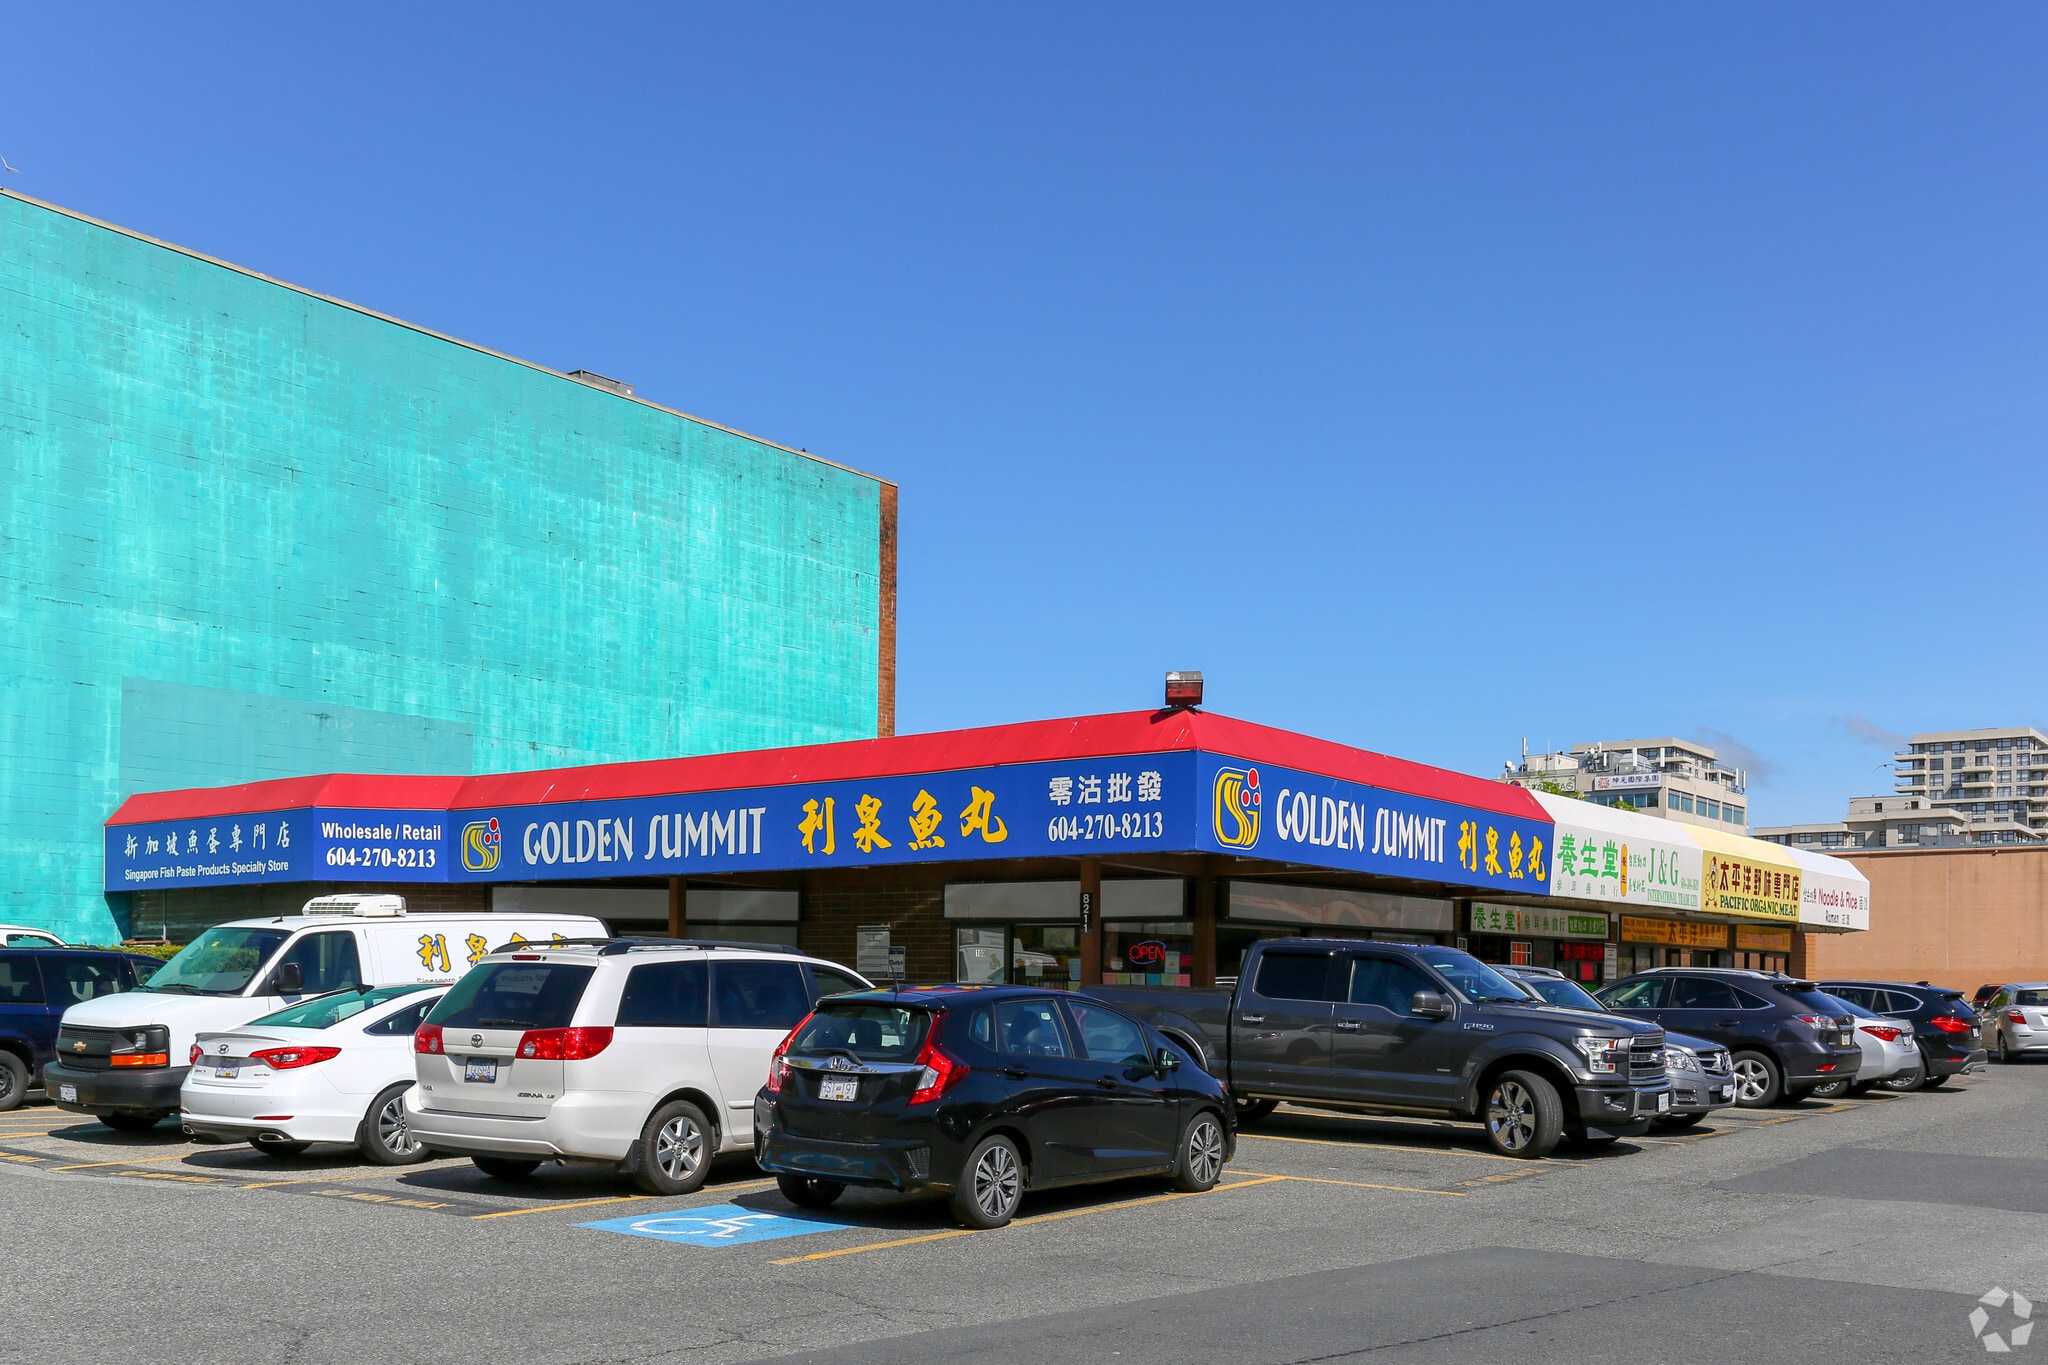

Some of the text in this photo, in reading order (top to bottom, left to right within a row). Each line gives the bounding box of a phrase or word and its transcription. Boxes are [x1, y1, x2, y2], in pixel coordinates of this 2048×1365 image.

[1048, 771, 1163, 806] 零沽批發
[322, 822, 392, 841] Wholesale
[403, 824, 441, 841] Retail
[523, 807, 767, 865] GOLDEN SUMMIT
[797, 785, 1008, 856] 利泉魚丸
[1048, 811, 1163, 842] 604-270-8213
[1276, 788, 1447, 864] GOLDEN SUMMIT
[124, 820, 290, 860] 新加坡魚蛋專門店
[326, 847, 437, 868] 604-270-8213
[1457, 819, 1547, 882] 利泉魚丸
[1557, 833, 1619, 880] 養生堂
[125, 859, 289, 882] Singapore Fish Paste Products Specialty Store
[1648, 848, 1655, 883] J
[1658, 849, 1667, 885] &
[1670, 851, 1679, 886] G
[1719, 861, 1799, 902] 太平洋野味專門店
[1082, 893, 1090, 933] 8211
[1720, 894, 1798, 917] PACIFIC ORGANIC MEAT
[1818, 888, 1838, 907] Noodle
[1846, 891, 1857, 910] Rice
[1474, 905, 1516, 931] 養生堂
[1129, 945, 1166, 960] OPEN
